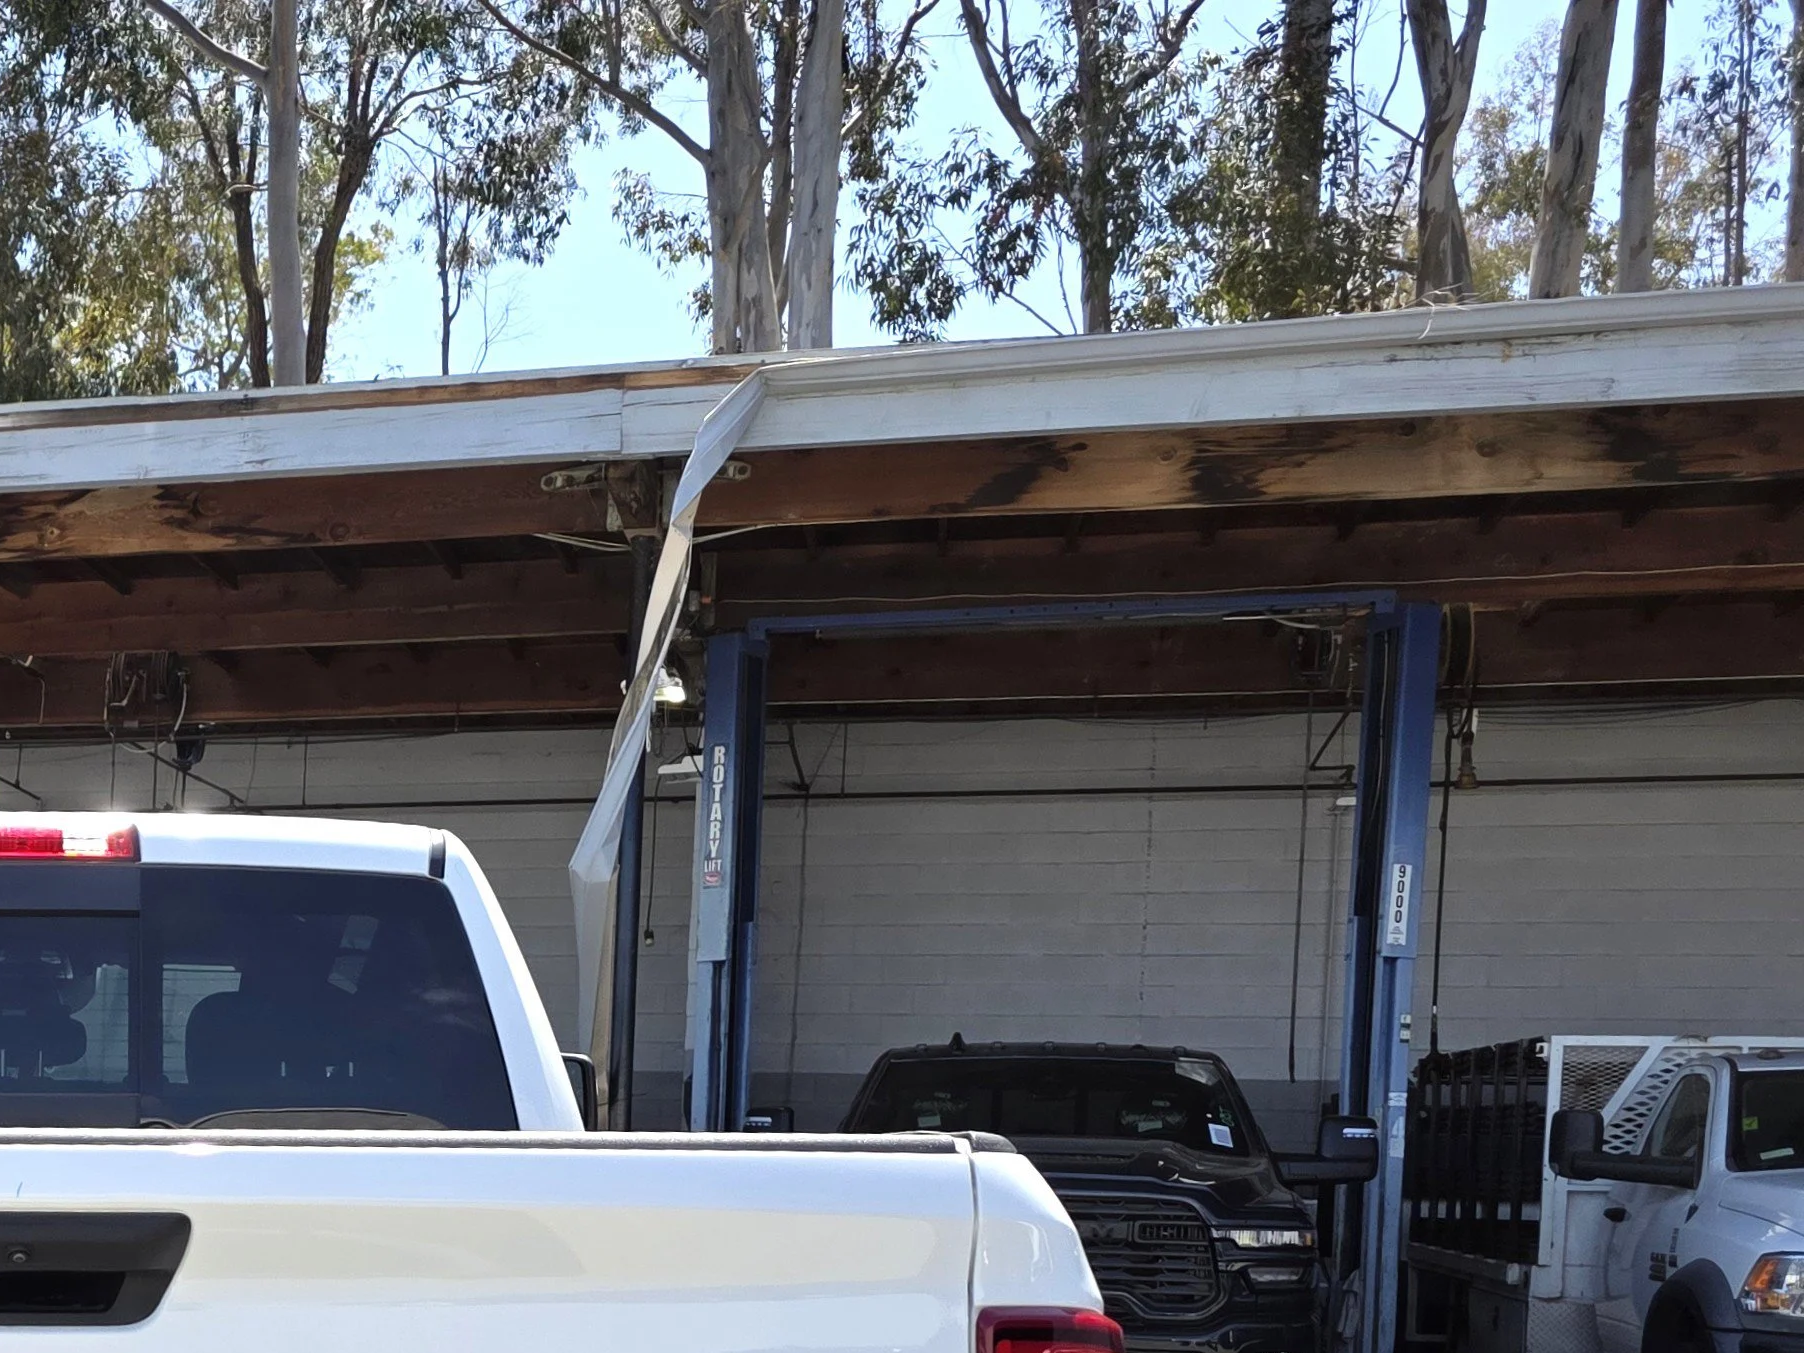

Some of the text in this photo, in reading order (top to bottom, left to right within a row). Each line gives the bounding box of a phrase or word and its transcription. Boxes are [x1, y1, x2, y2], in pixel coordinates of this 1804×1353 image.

[709, 745, 726, 859] ROTARY
[704, 859, 722, 873] LIFT
[1394, 864, 1406, 923] 9000
